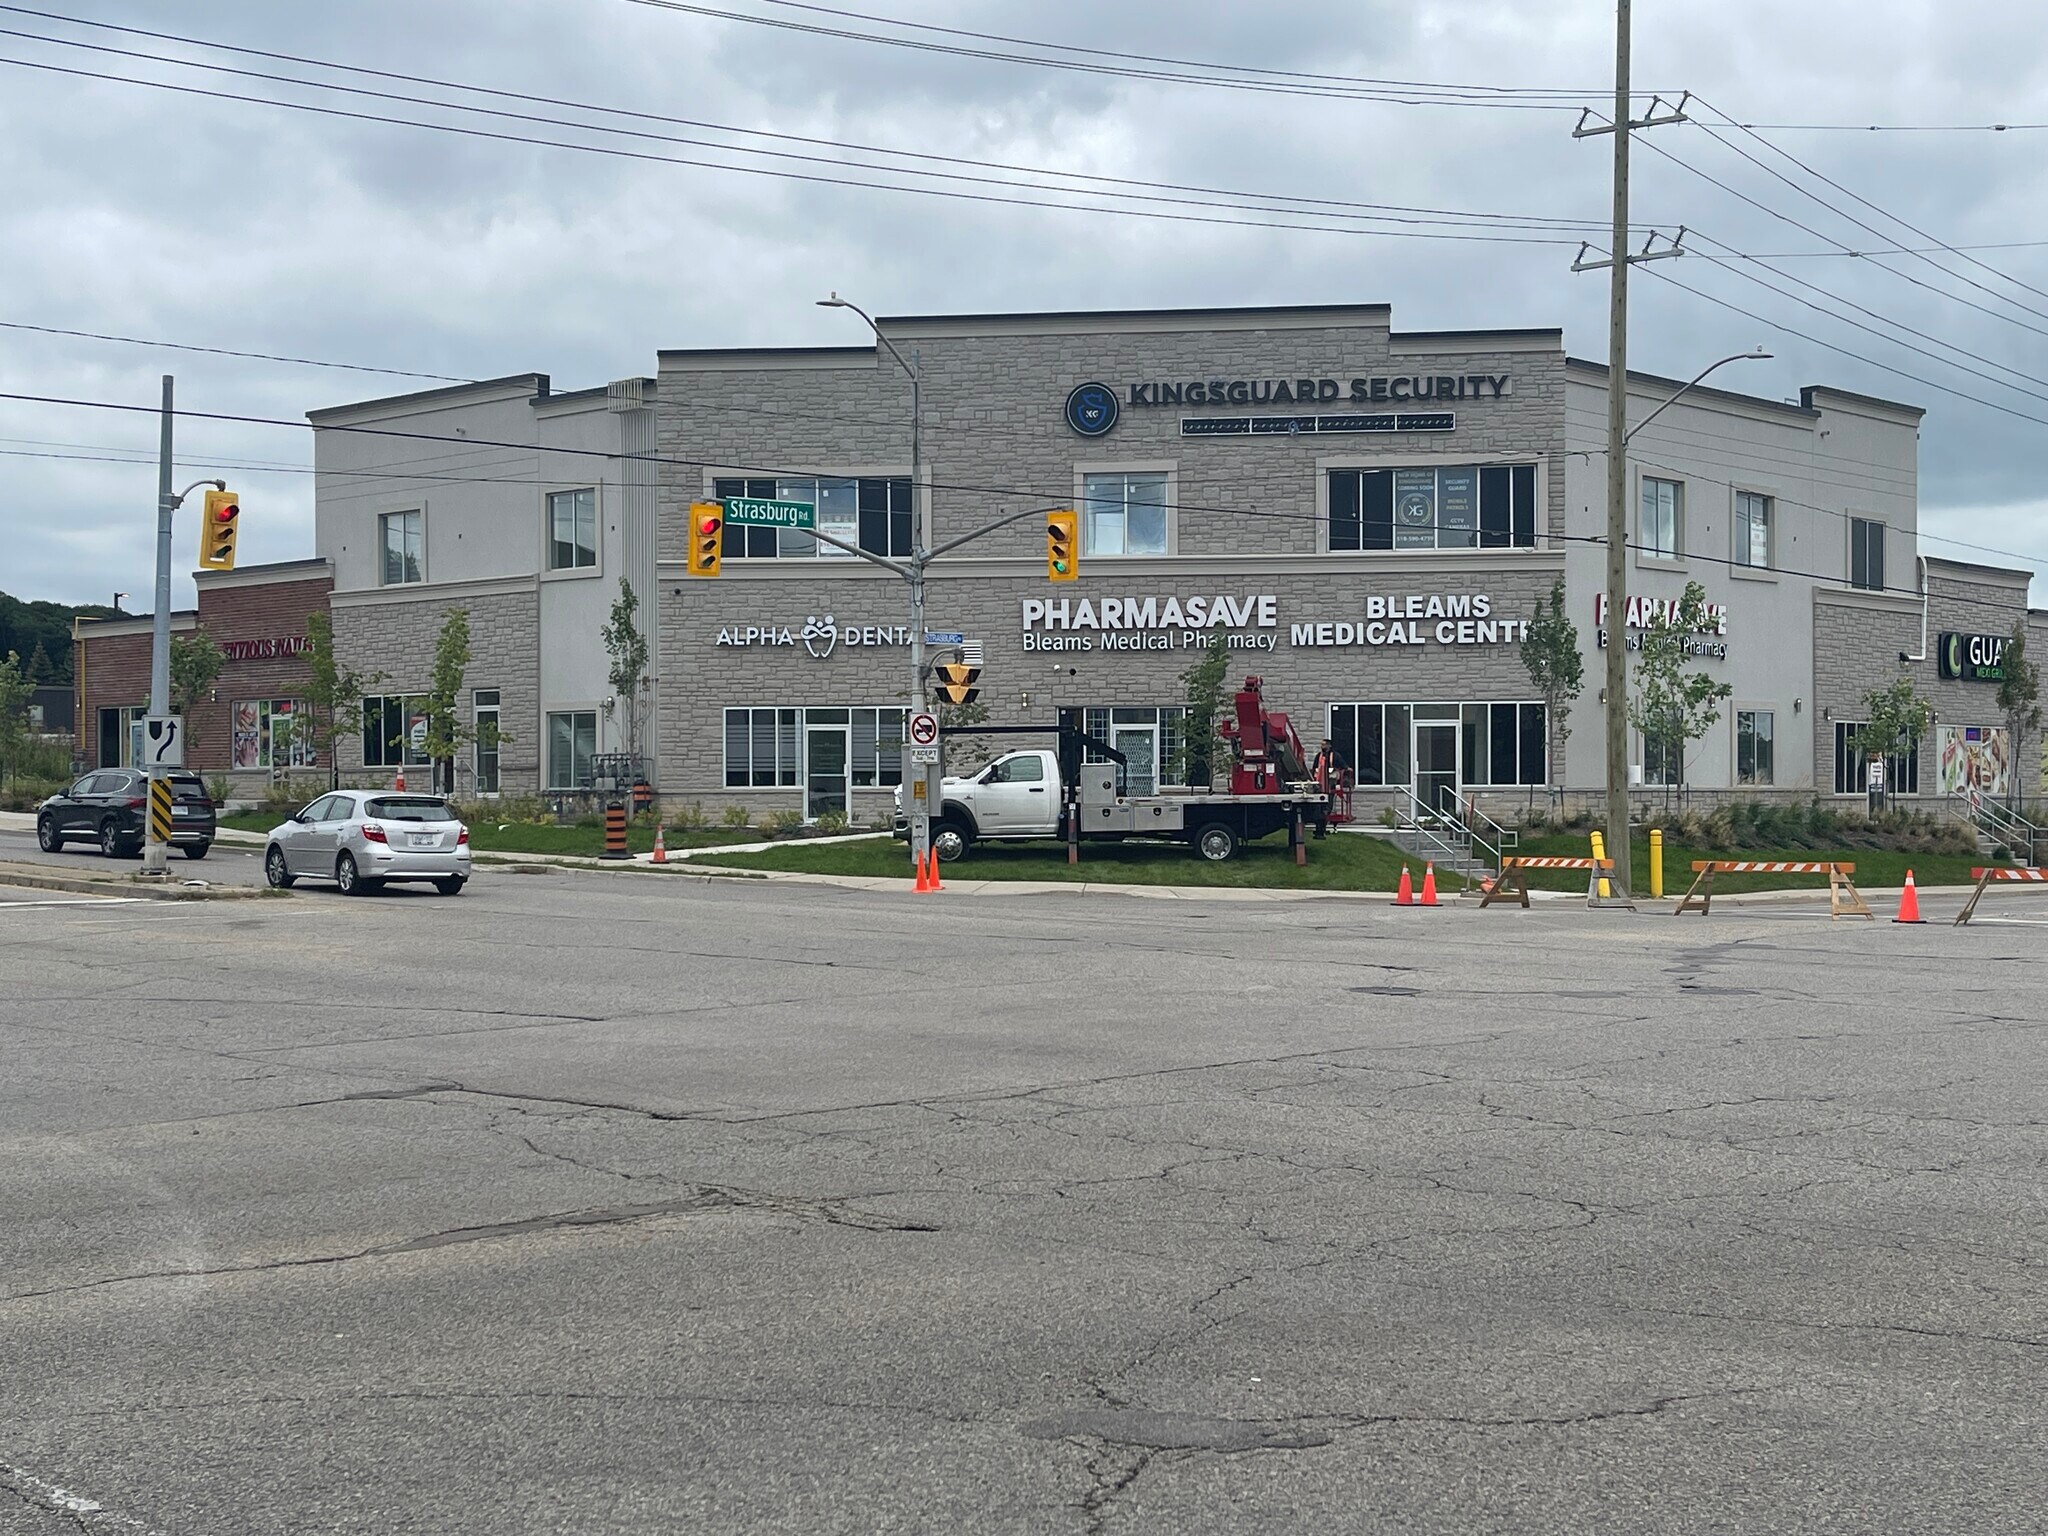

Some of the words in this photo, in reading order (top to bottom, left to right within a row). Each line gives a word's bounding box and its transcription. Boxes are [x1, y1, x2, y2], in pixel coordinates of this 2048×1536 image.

[1131, 379, 1339, 406] KINGSGUARD
[1351, 375, 1508, 401] SECURITY
[730, 500, 798, 526] Strasburg
[799, 511, 810, 521] Rd.
[1022, 595, 1277, 629] PHARMASAVE
[1366, 595, 1490, 619] BLEAMS
[716, 626, 794, 645] ALPHA
[1023, 632, 1092, 651] Bleams
[1100, 631, 1175, 650] Medical
[1183, 630, 1278, 651] Phamacy
[1291, 621, 1425, 646] MEDICAL
[912, 749, 937, 757] EXCEPT
